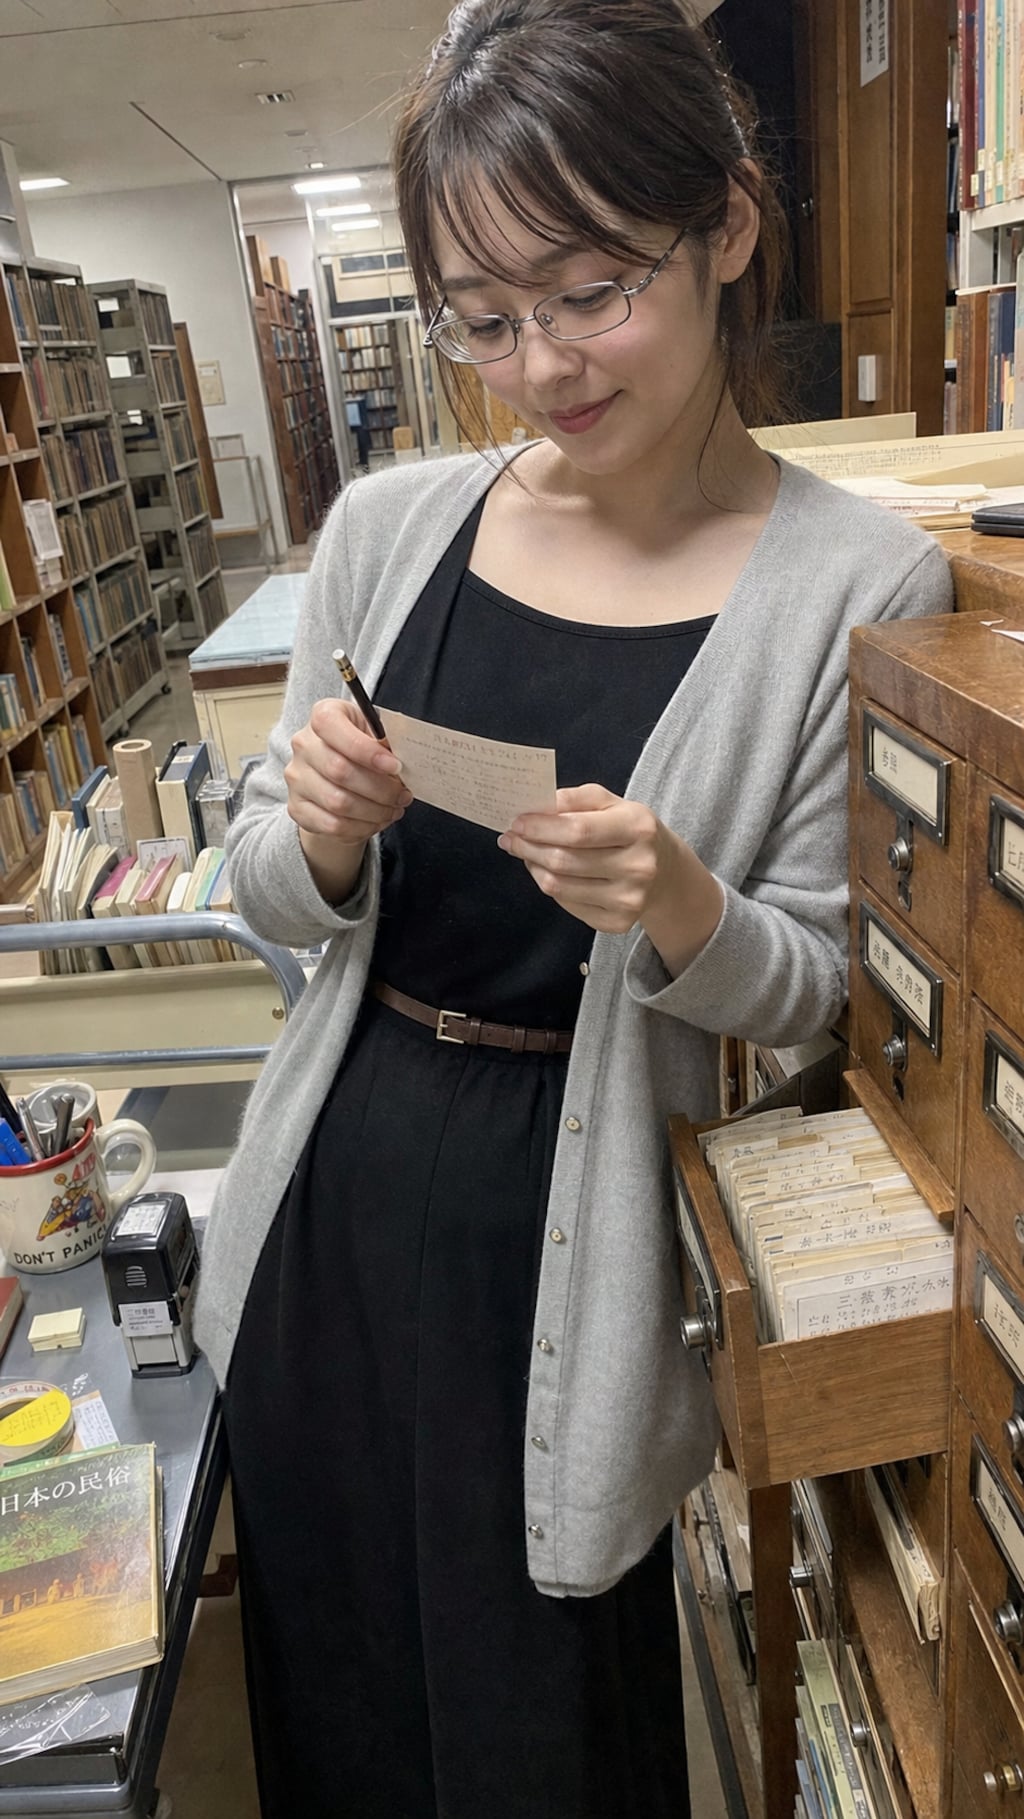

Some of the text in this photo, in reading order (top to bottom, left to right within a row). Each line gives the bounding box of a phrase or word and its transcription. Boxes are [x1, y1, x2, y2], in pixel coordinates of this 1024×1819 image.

[14, 1251, 55, 1264] DON'T
[1, 1466, 131, 1516] 日本の民俗
